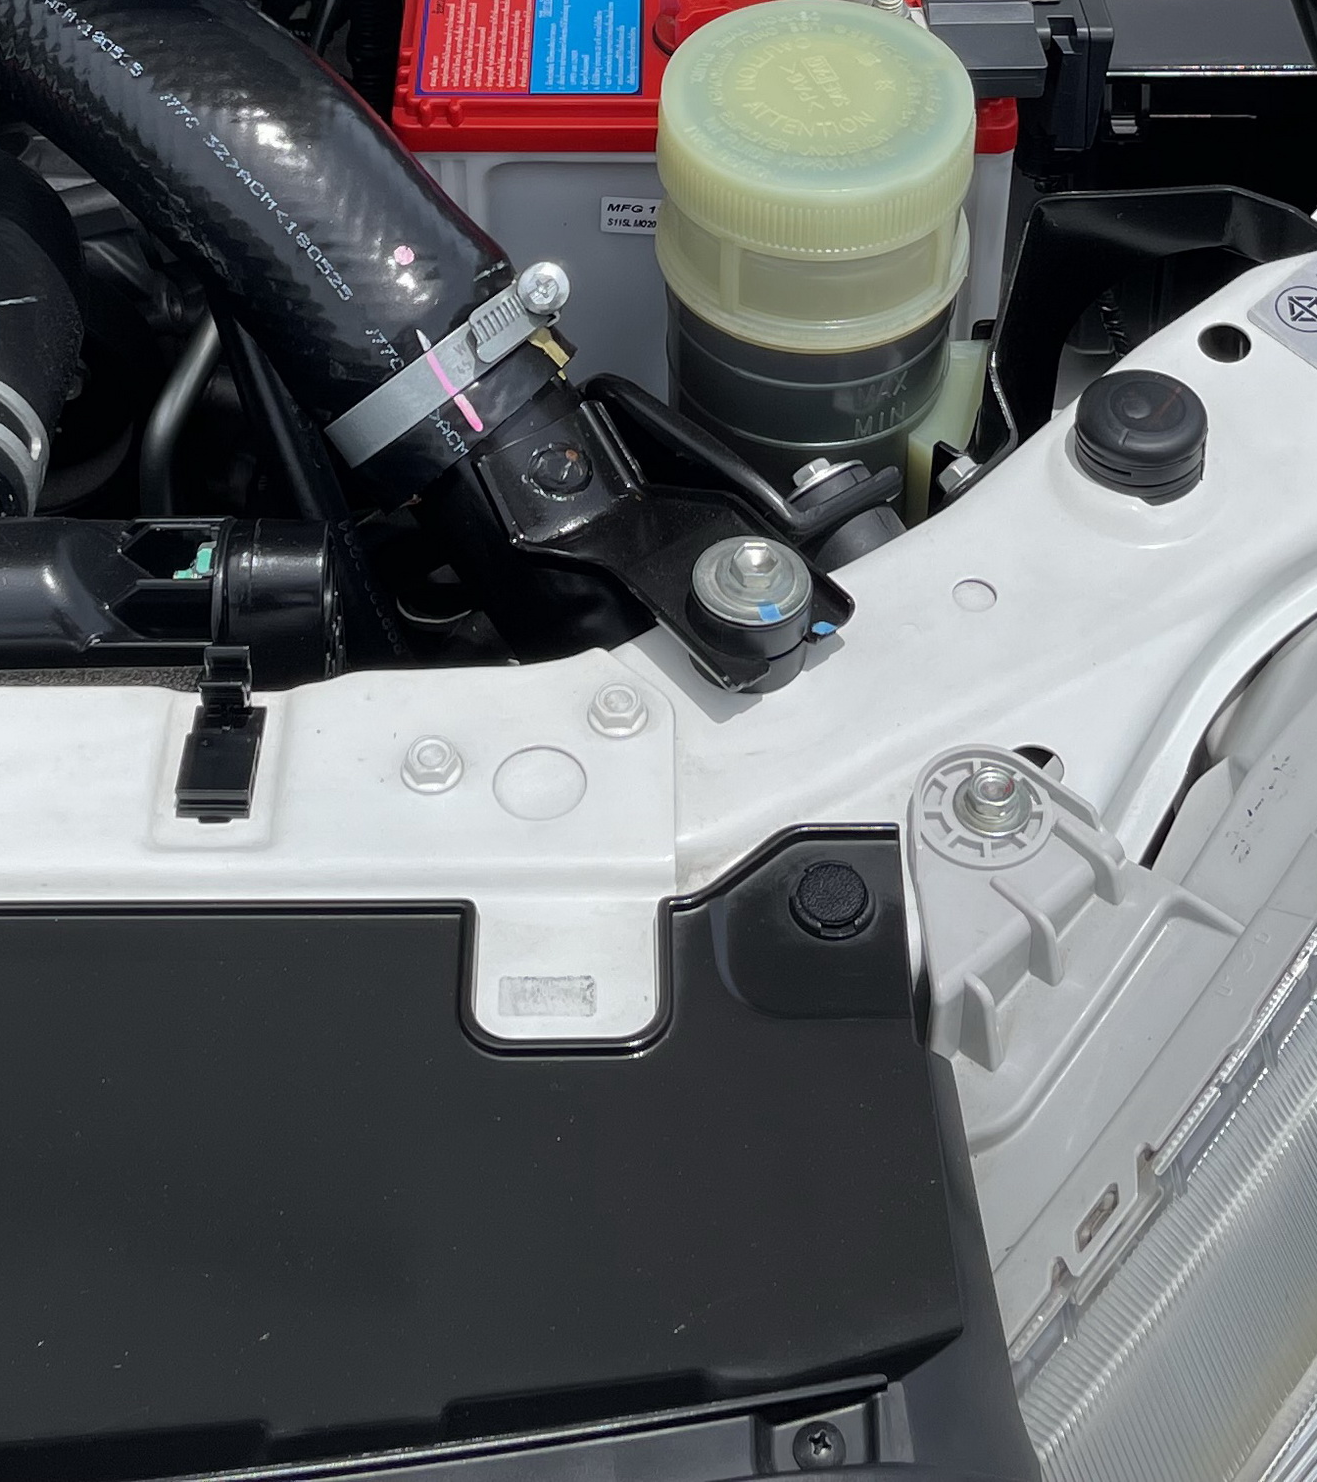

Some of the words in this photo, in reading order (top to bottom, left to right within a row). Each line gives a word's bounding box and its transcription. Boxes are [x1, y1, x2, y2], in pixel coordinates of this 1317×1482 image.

[743, 100, 880, 139] ATTENTION
[607, 203, 644, 215] MFG
[854, 401, 906, 437] MIN
